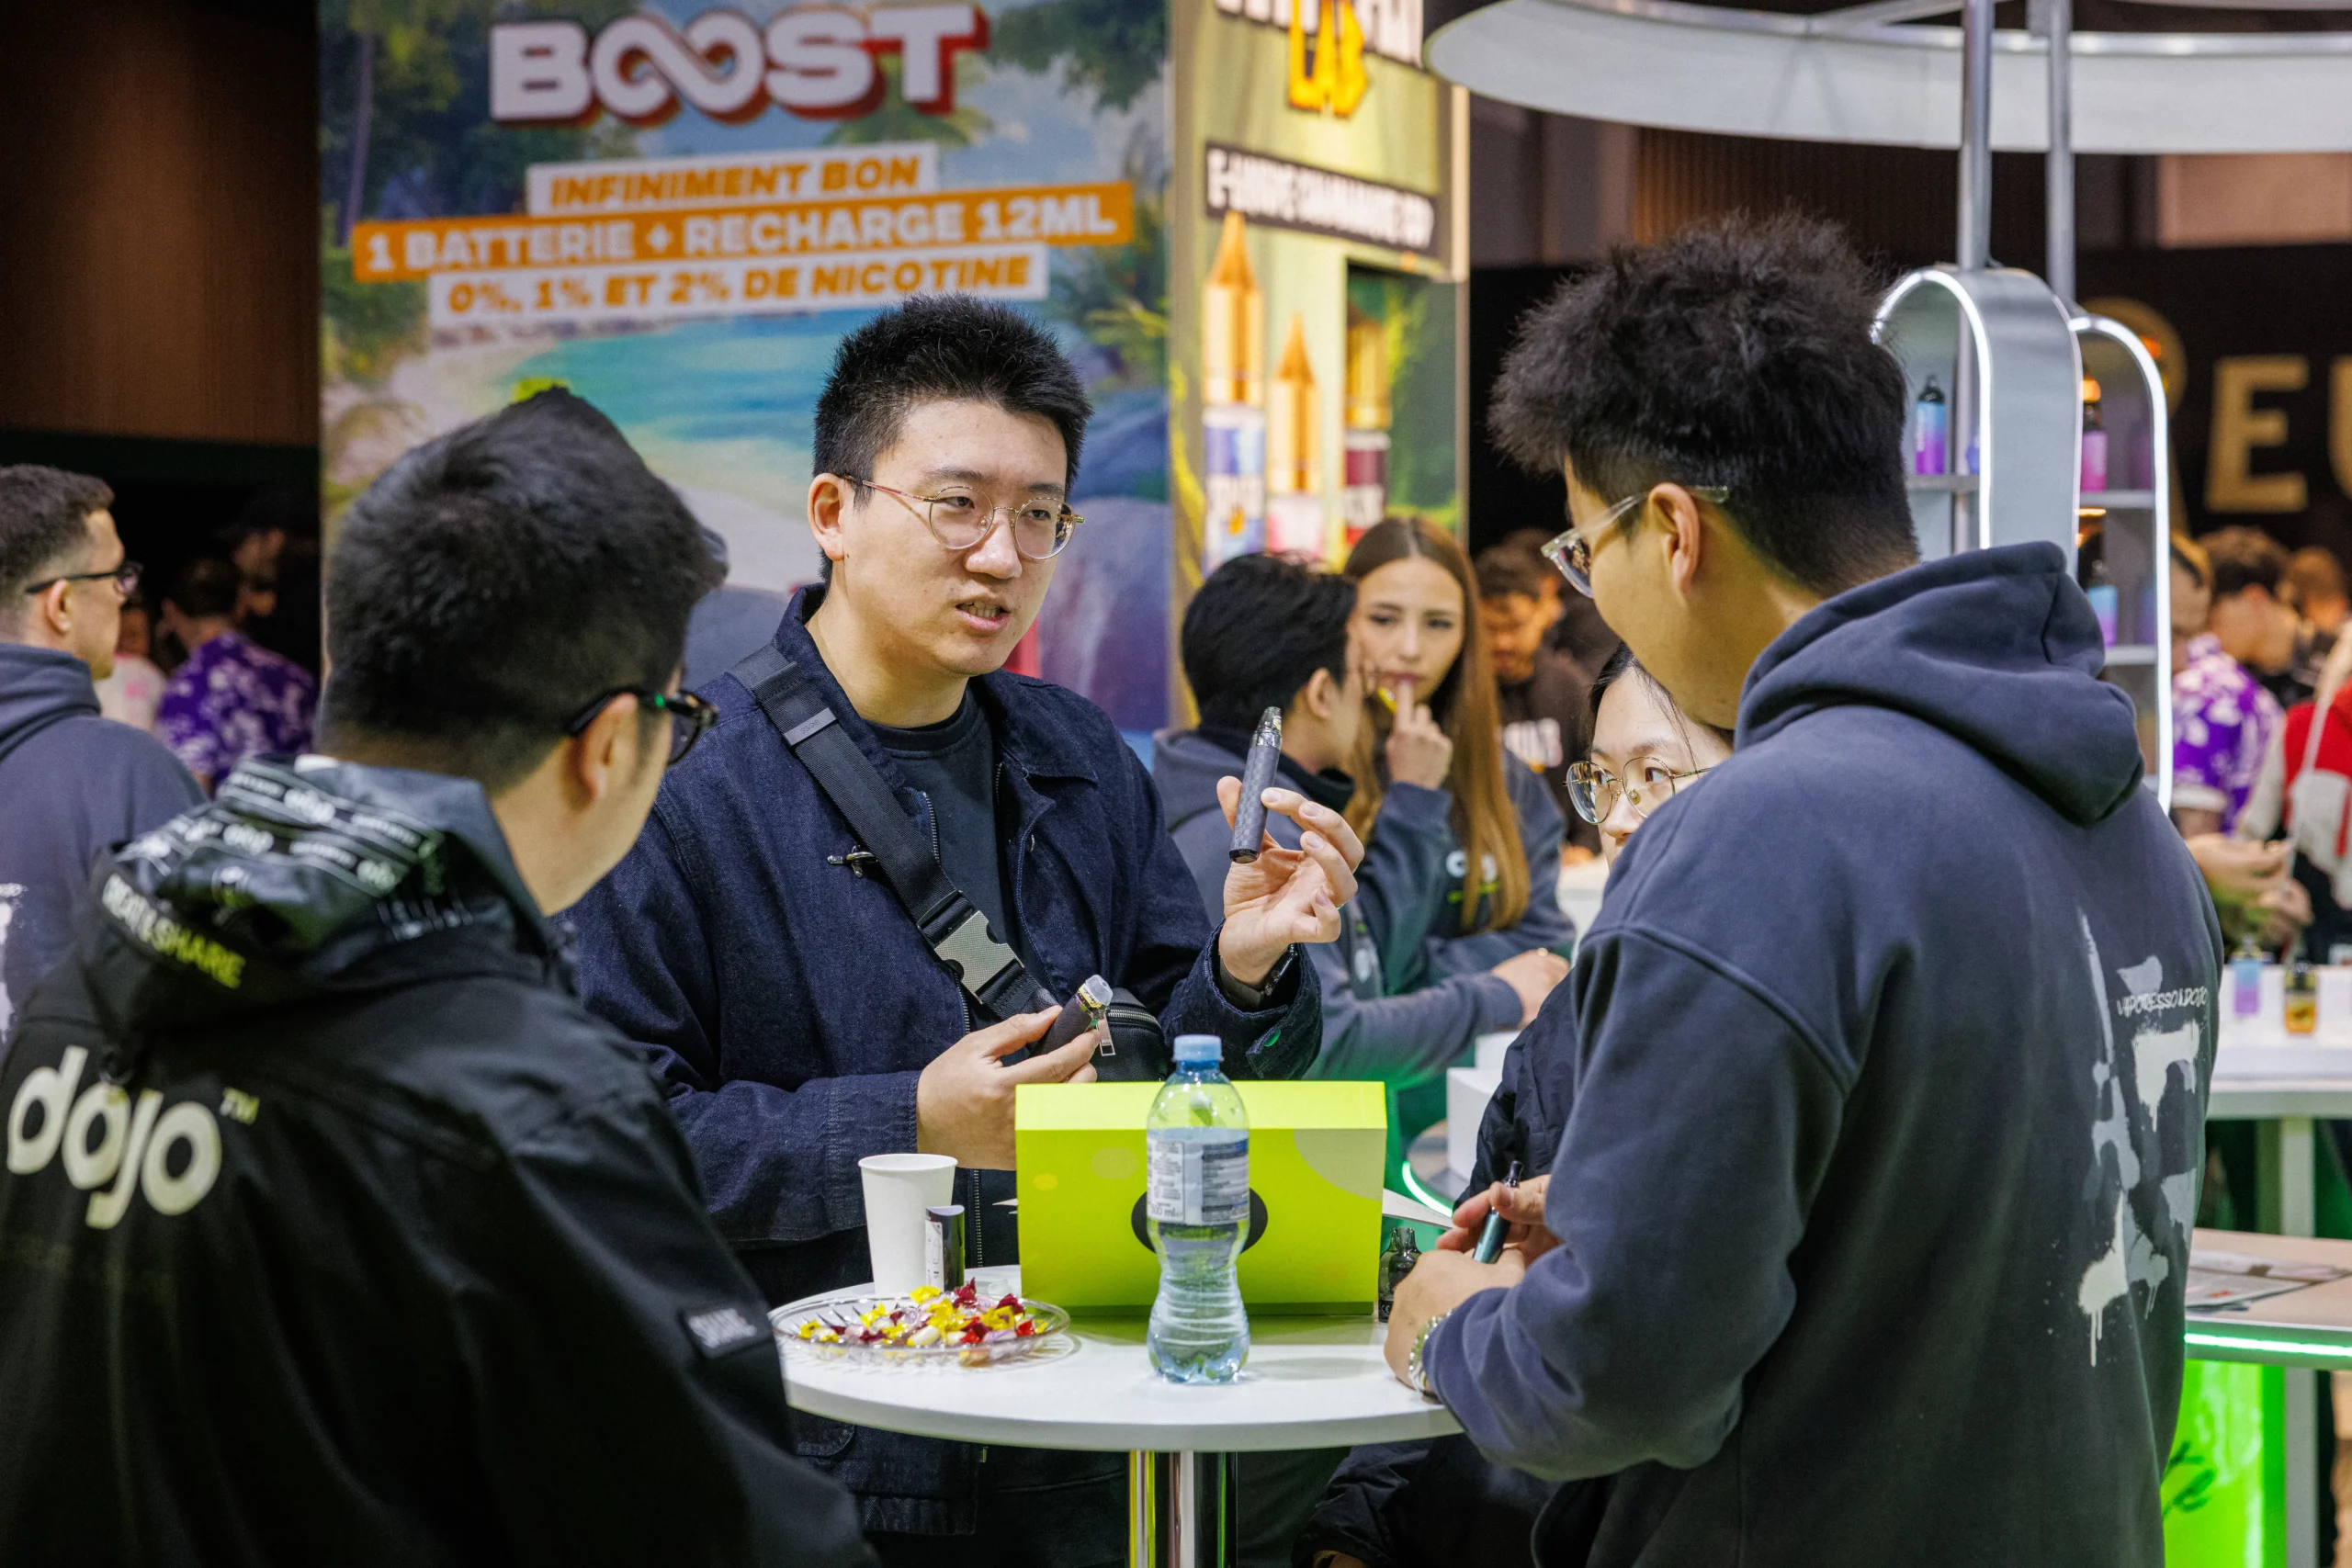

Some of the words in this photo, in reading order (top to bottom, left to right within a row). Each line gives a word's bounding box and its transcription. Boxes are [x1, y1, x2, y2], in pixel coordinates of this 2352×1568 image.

[490, 4, 987, 126] BOOST
[551, 164, 808, 206] INFINIMENT
[821, 156, 920, 192] BON
[368, 234, 394, 272] 1
[405, 220, 635, 270] BATTERIE
[684, 201, 966, 254] RECHARGE
[535, 278, 593, 310] 1%
[605, 276, 656, 307] ET
[671, 270, 730, 304] 2%
[745, 268, 800, 299] DE
[811, 255, 1031, 294] NICOTINE
[7, 1045, 222, 1230] dojo
